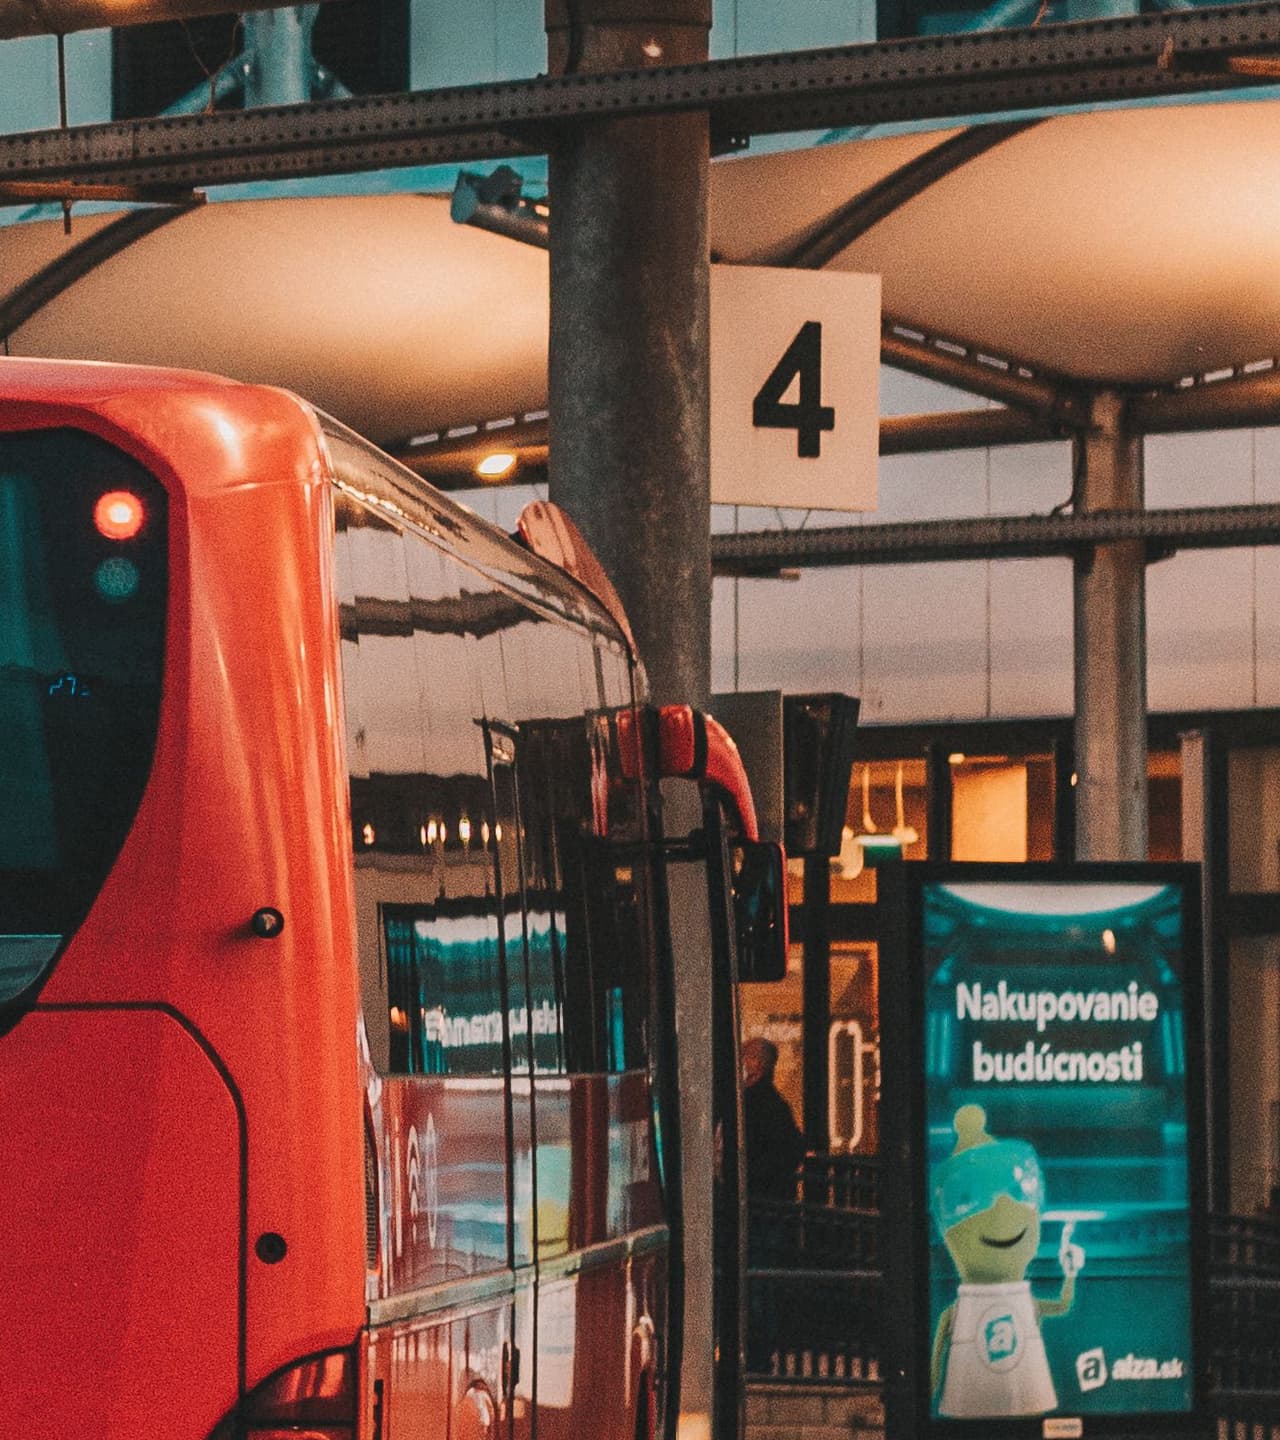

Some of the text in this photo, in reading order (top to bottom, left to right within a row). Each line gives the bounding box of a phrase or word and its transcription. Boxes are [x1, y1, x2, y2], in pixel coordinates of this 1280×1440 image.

[752, 320, 835, 459] 4
[955, 979, 1159, 1033] Nakupovanie
[972, 1040, 1143, 1082] budúcnosti
